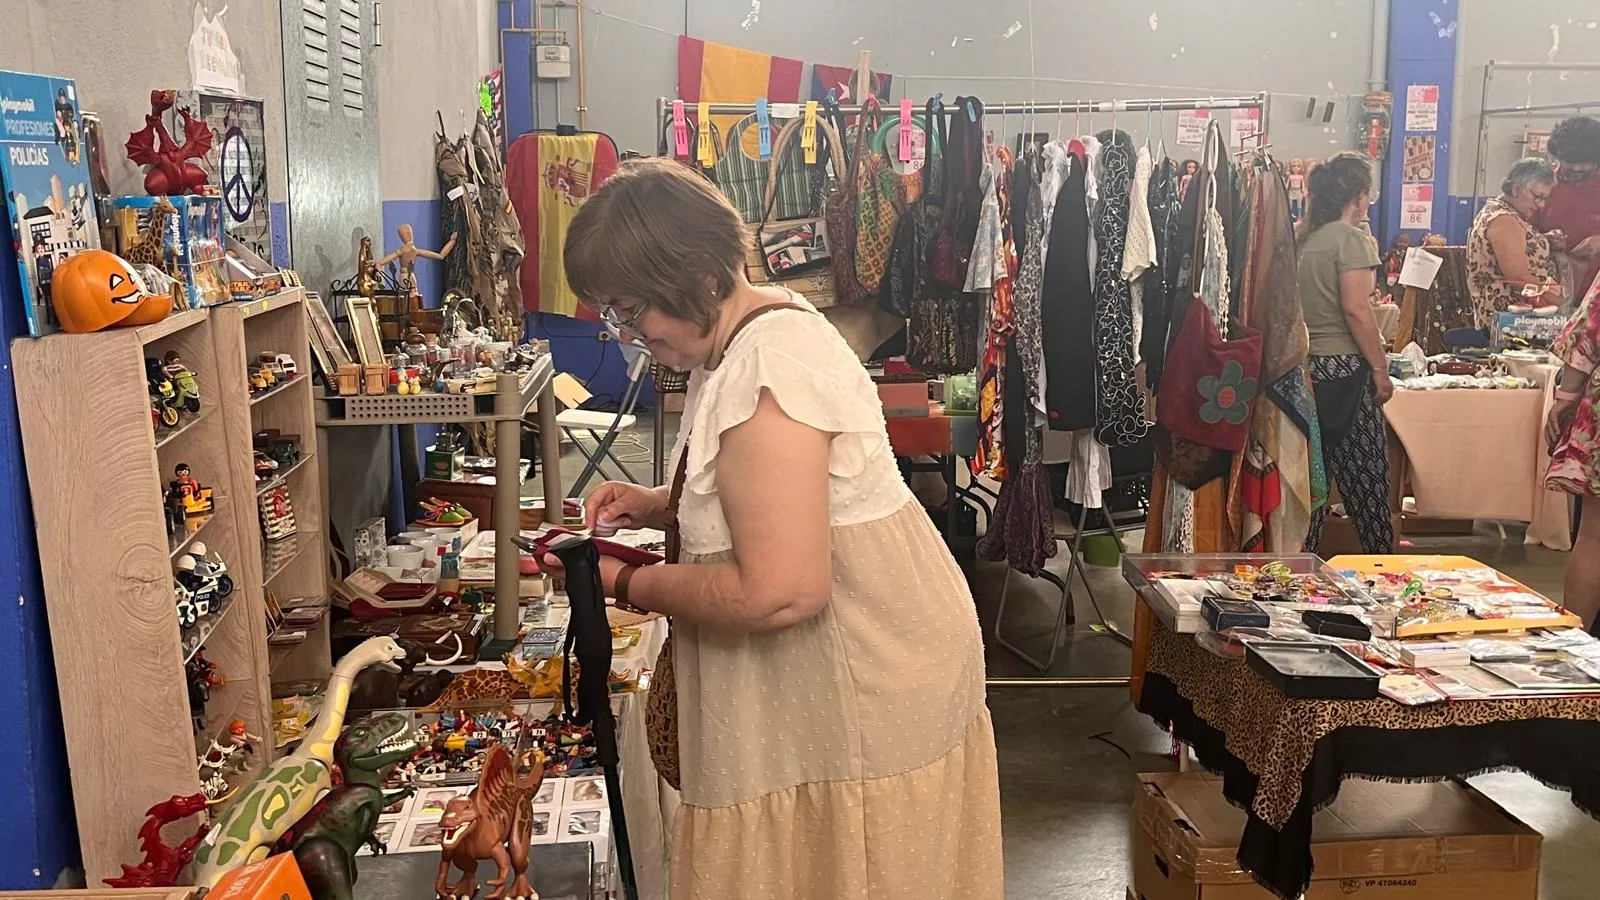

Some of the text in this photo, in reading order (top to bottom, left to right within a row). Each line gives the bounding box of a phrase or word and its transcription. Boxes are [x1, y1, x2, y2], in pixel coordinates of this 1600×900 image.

[5, 119, 55, 138] PROFESIONES
[10, 144, 49, 166] POLICÍAS
[171, 212, 184, 256] laymobil
[1514, 316, 1568, 328] playmobil
